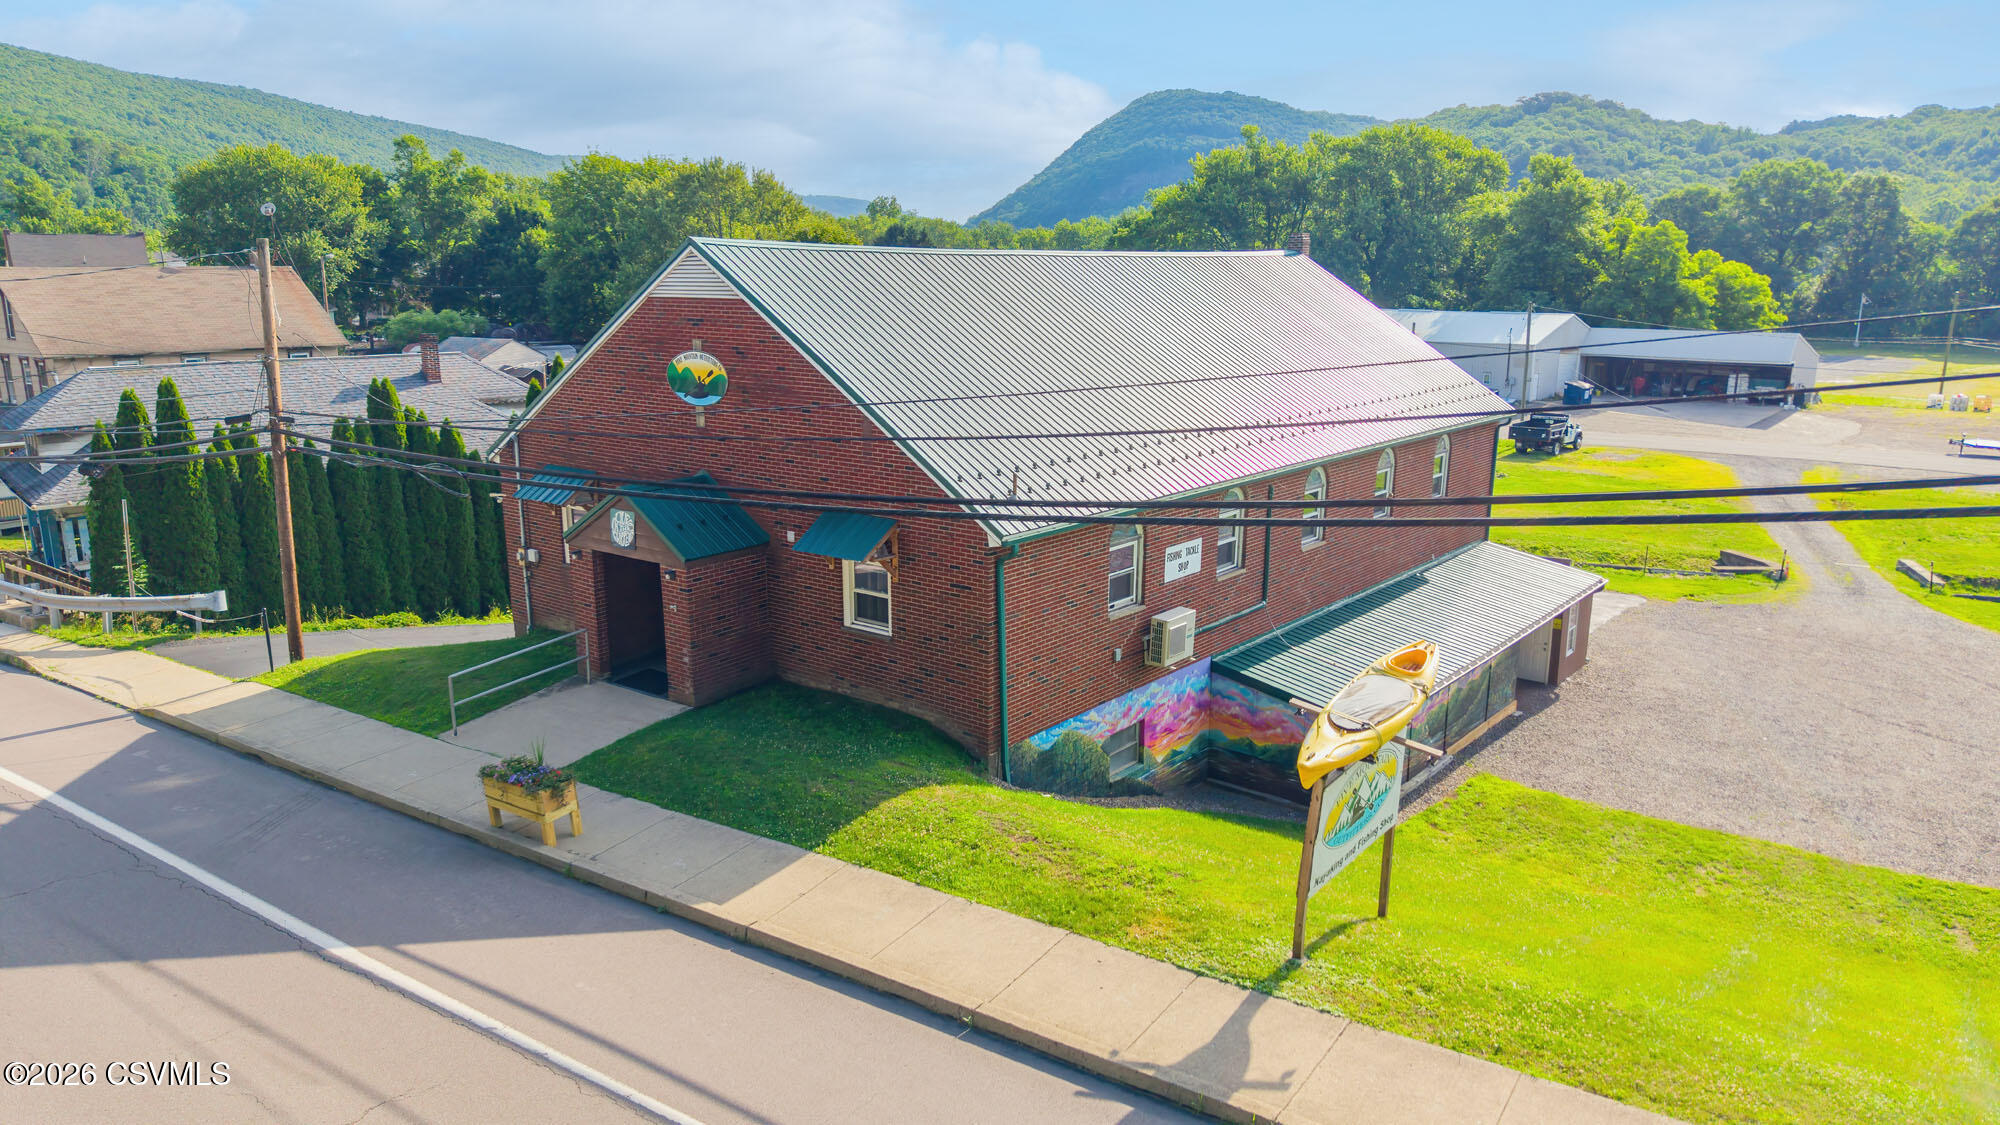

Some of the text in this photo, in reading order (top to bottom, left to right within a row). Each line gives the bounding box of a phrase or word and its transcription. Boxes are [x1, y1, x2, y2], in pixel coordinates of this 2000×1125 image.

[1167, 544, 1200, 562] FISHING TACKLE
[1178, 560, 1190, 572] SHOP
[1313, 813, 1394, 888] Kayaking and Fishing Shop
